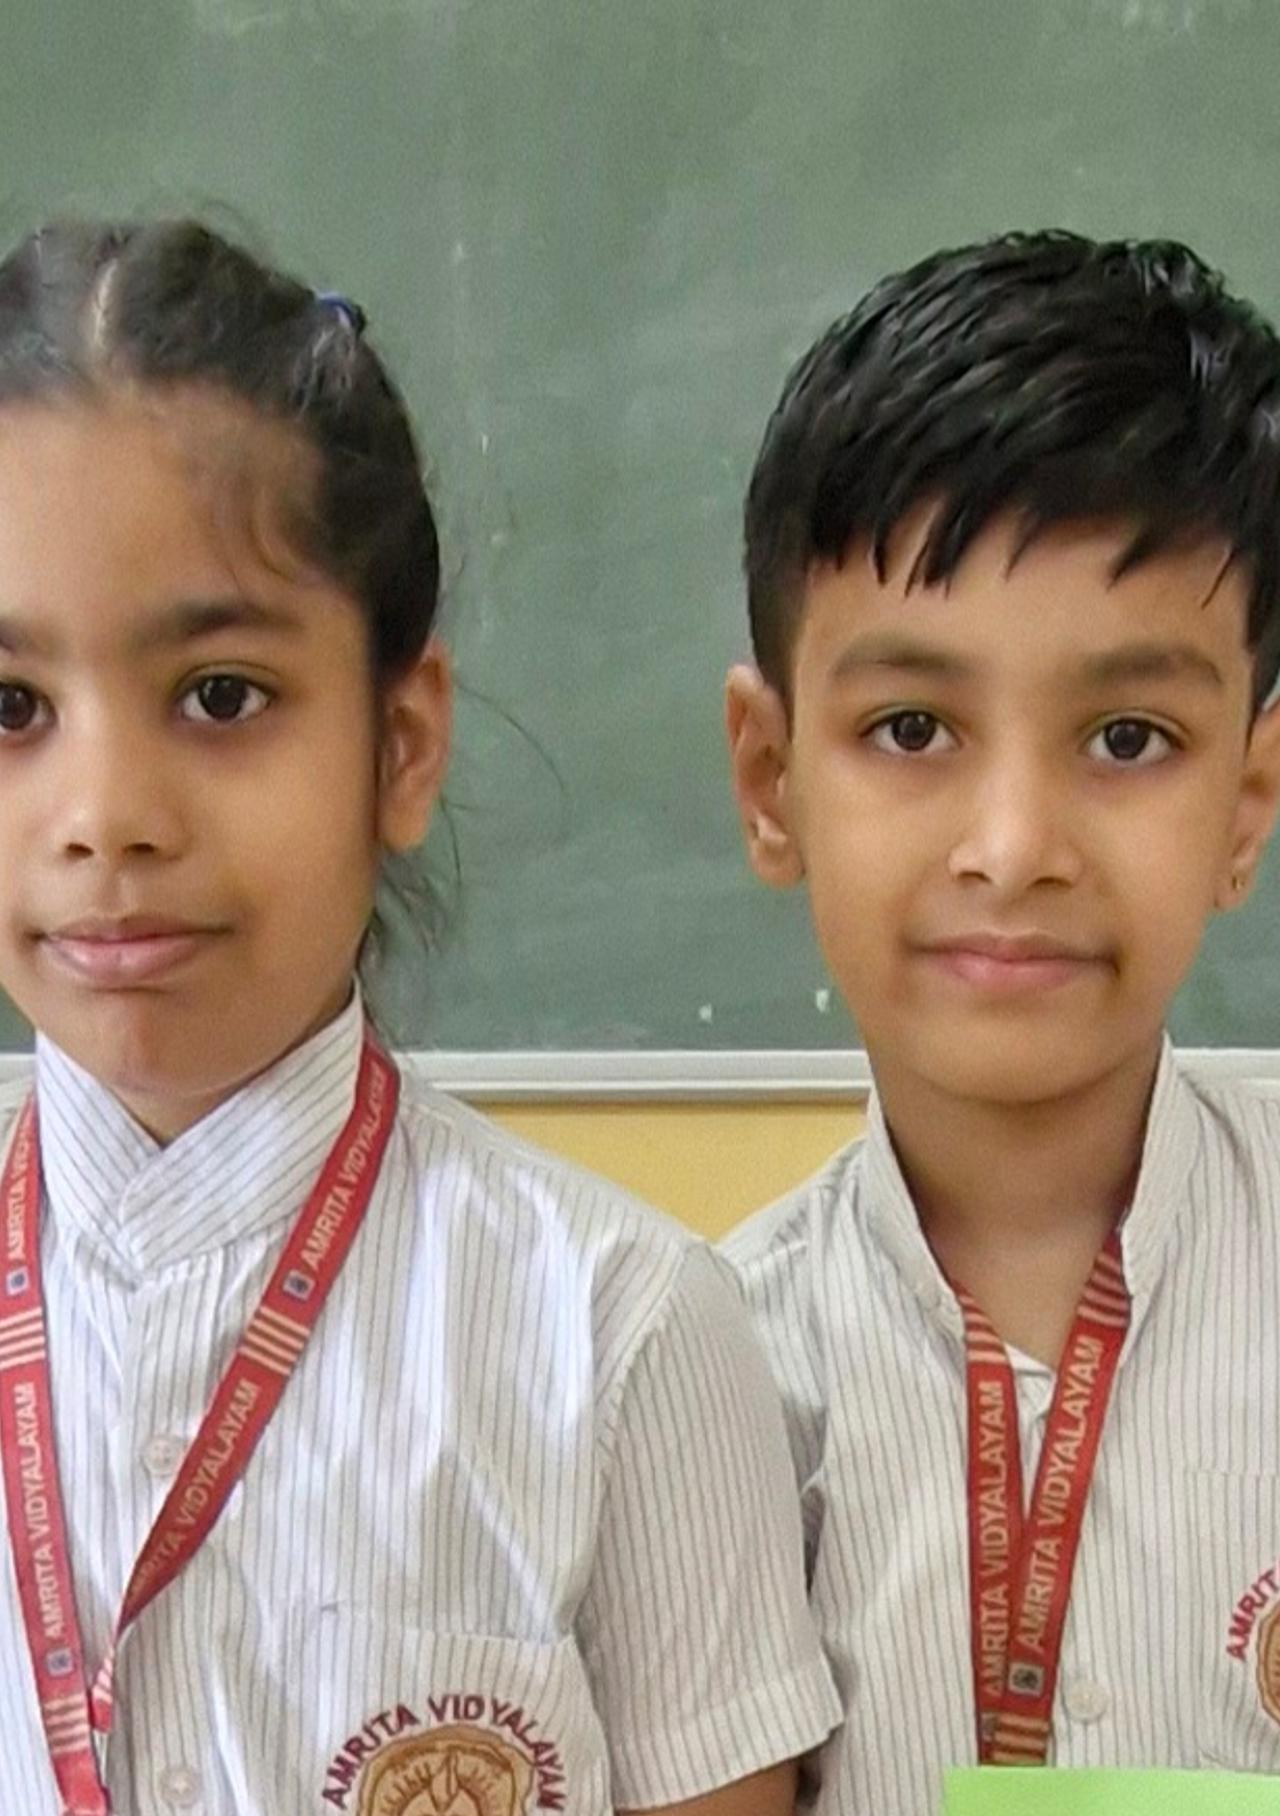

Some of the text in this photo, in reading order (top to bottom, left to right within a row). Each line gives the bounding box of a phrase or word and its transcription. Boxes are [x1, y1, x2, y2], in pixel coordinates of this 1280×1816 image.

[300, 1185, 355, 1270] AMRITA
[14, 1382, 64, 1640] AMRITA VIDYALAYAM
[176, 1377, 261, 1527] VIDYALAYAM
[978, 1381, 1010, 1697] AMRITA VIDYALAYAM
[1014, 1334, 1103, 1653] AMRITA VIDYALAYAM
[322, 1694, 567, 1812] AMRITA VIDYALAYAM
